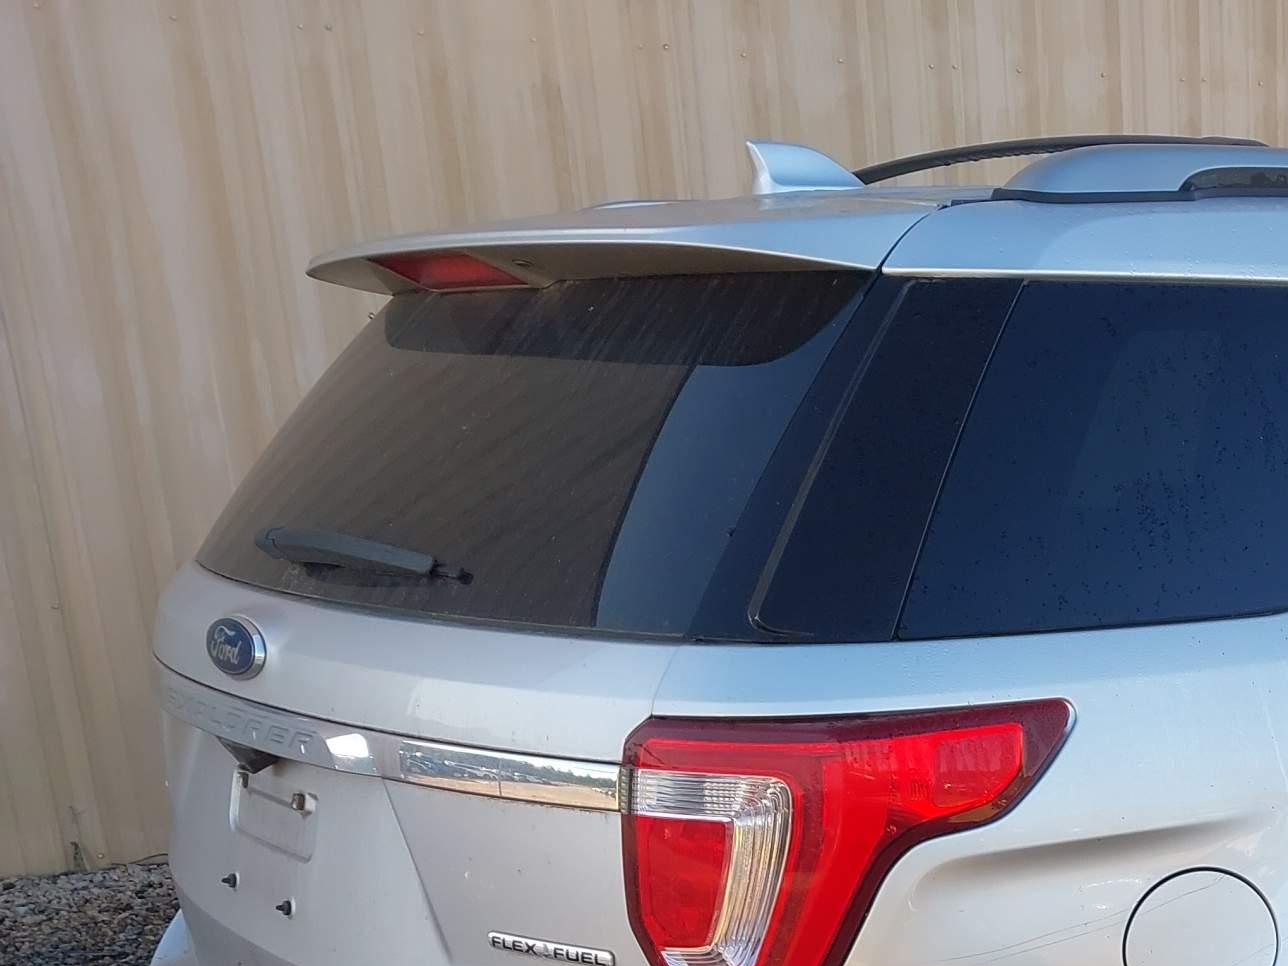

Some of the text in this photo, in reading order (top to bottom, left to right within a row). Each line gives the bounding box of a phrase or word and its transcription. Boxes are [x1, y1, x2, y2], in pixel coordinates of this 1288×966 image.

[211, 625, 242, 665] Ford
[165, 686, 317, 757] EXPLORER
[491, 935, 607, 966] FLEX FUEL
